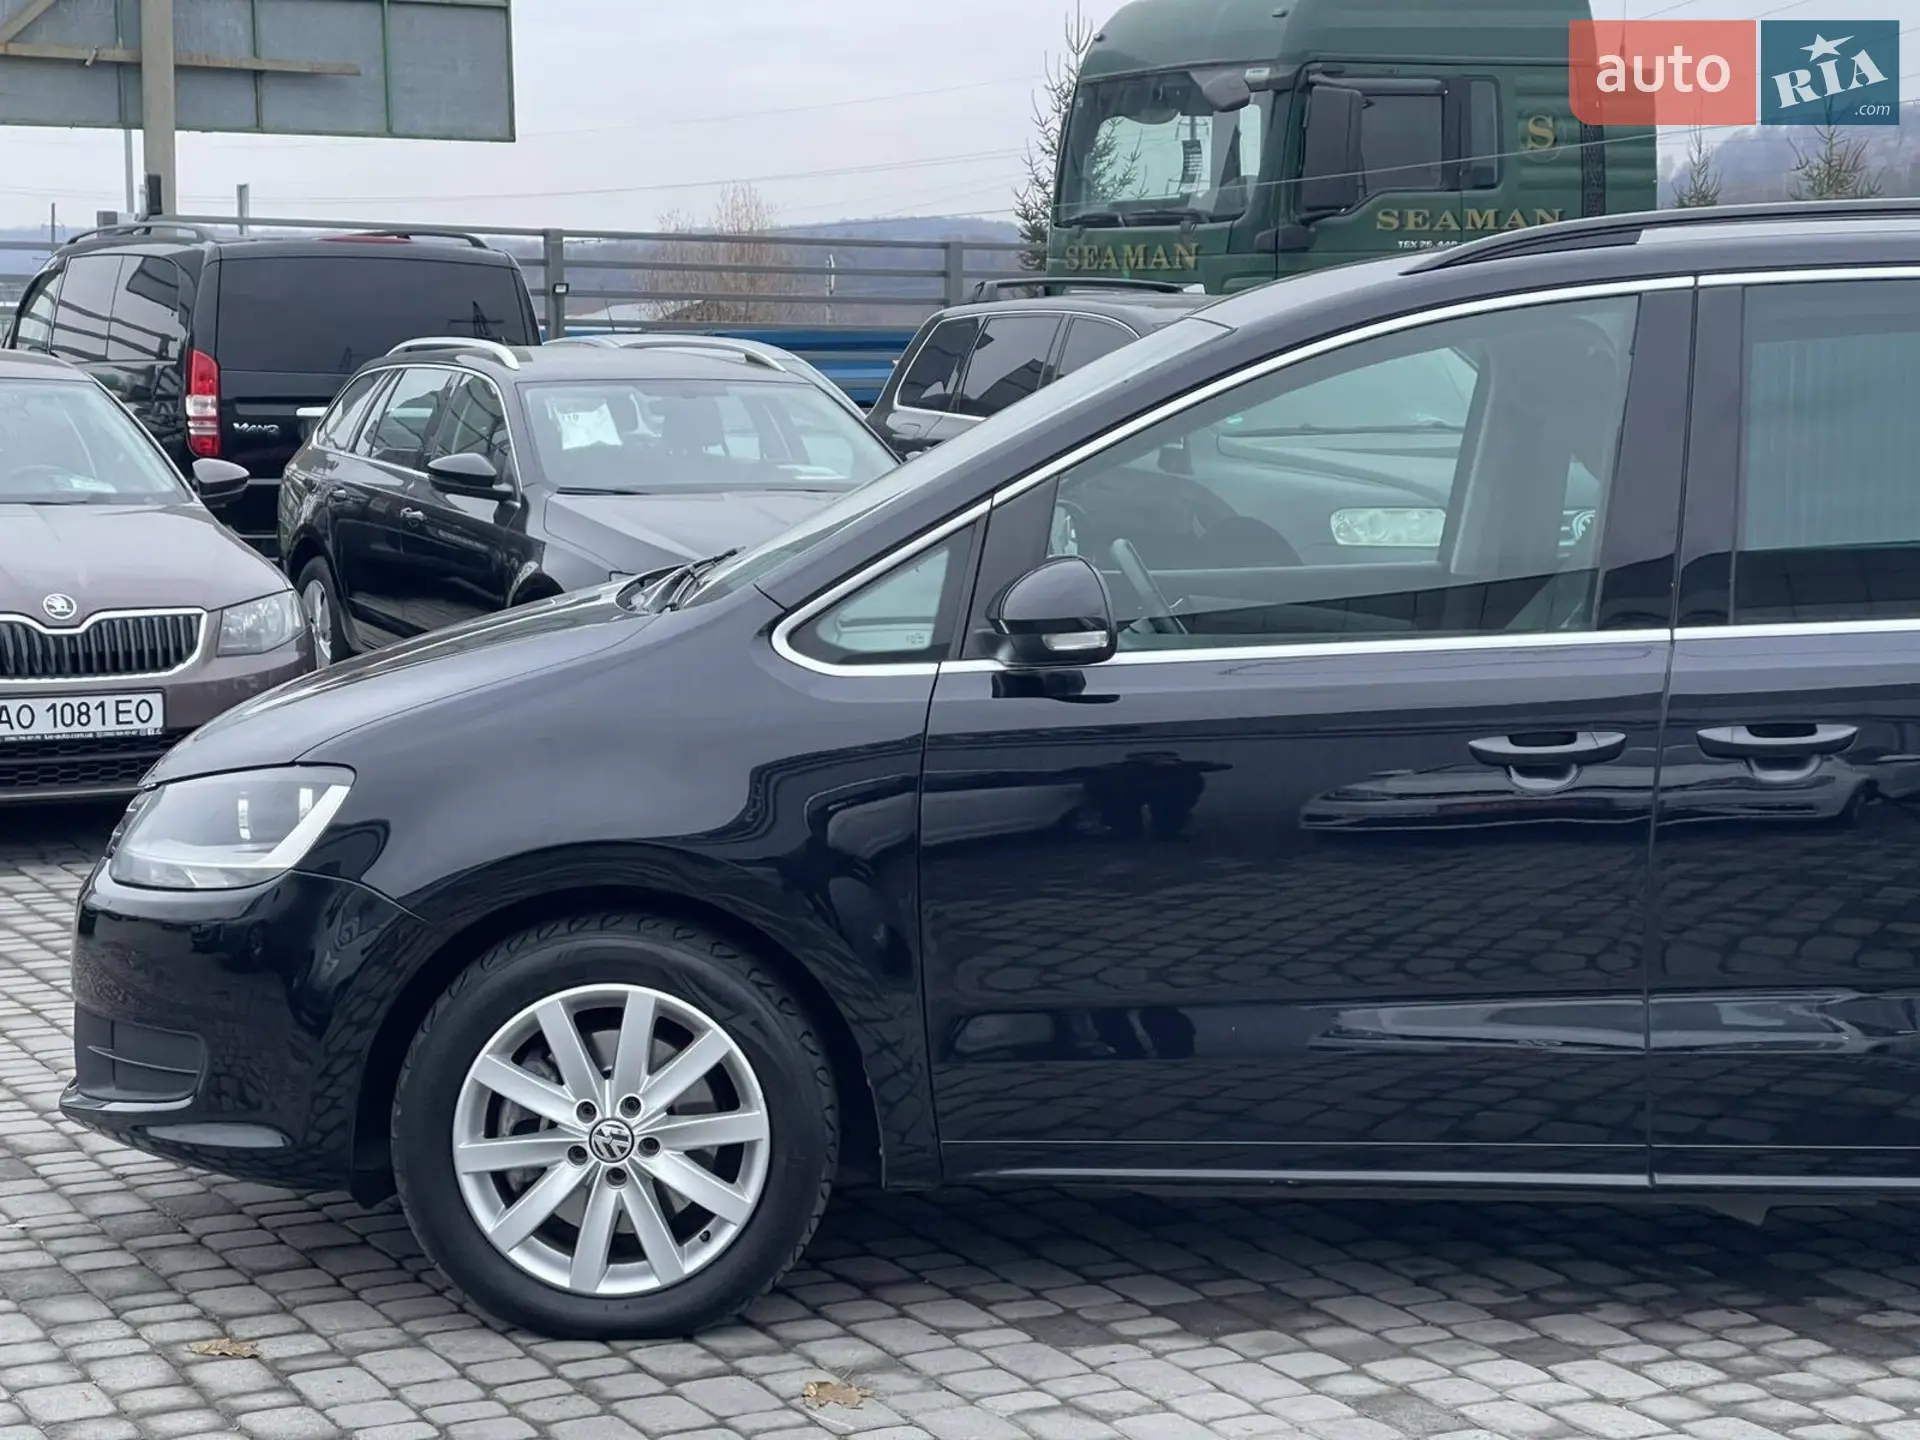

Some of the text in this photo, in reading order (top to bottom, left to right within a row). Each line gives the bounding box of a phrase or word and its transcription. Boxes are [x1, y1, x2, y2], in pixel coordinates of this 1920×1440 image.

[1376, 208, 1563, 232] SEAMAN
[1065, 242, 1199, 270] SEAMAN
[45, 700, 106, 728] 1081
[115, 698, 154, 725] EO
